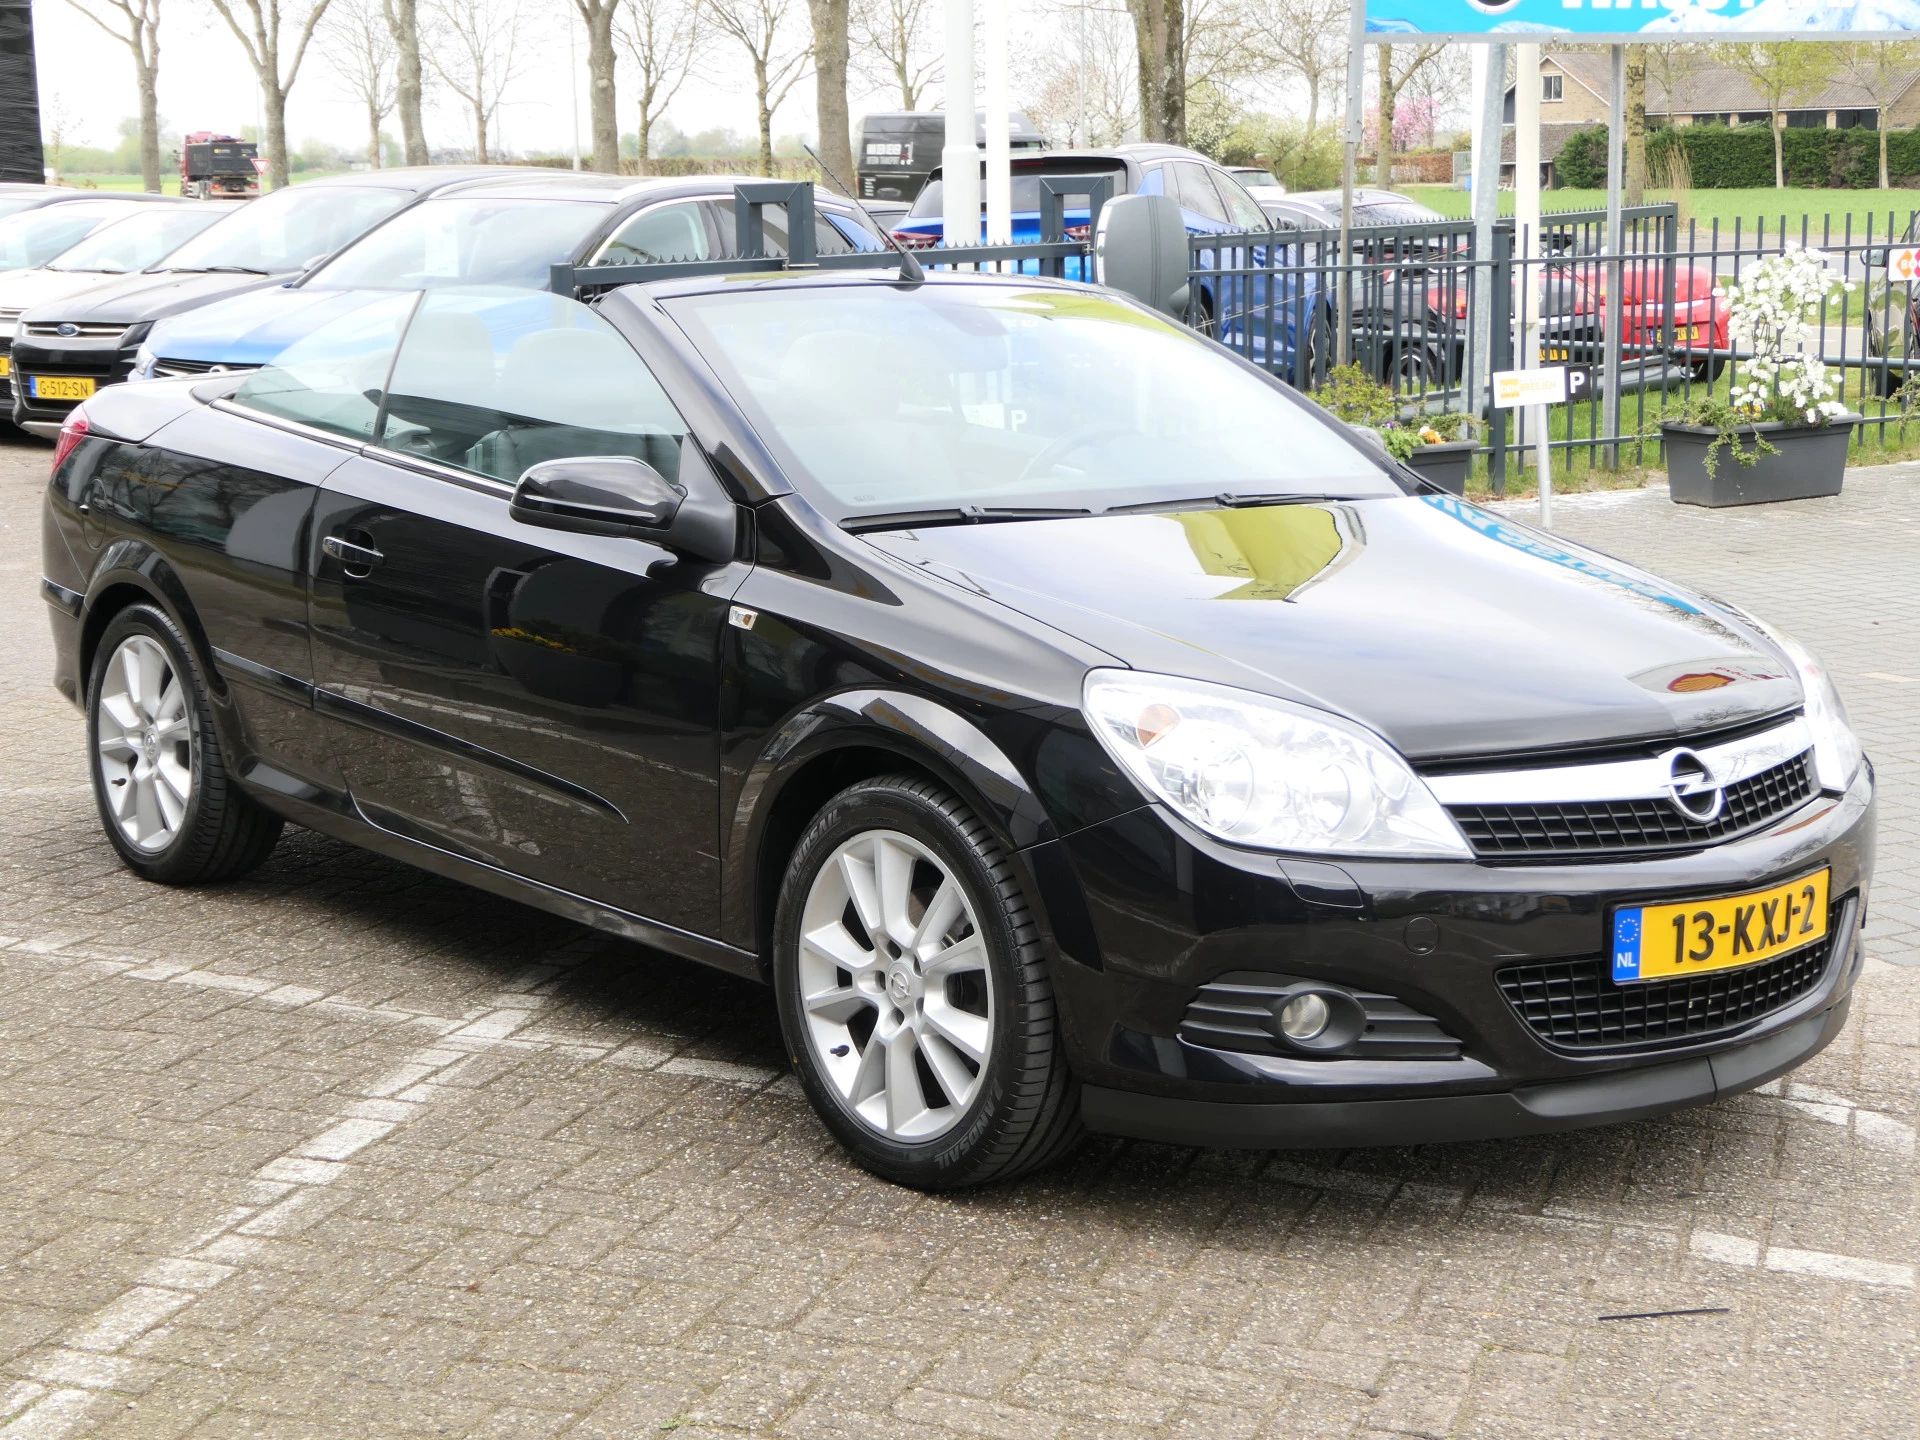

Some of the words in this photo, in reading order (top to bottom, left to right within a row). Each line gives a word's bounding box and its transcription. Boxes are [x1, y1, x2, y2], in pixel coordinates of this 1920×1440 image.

[40, 381, 88, 396] G-512-SN
[1569, 372, 1585, 394] P
[1010, 409, 1028, 432] P
[1672, 885, 1816, 963] 13-KXJ-2
[1616, 952, 1637, 968] NL
